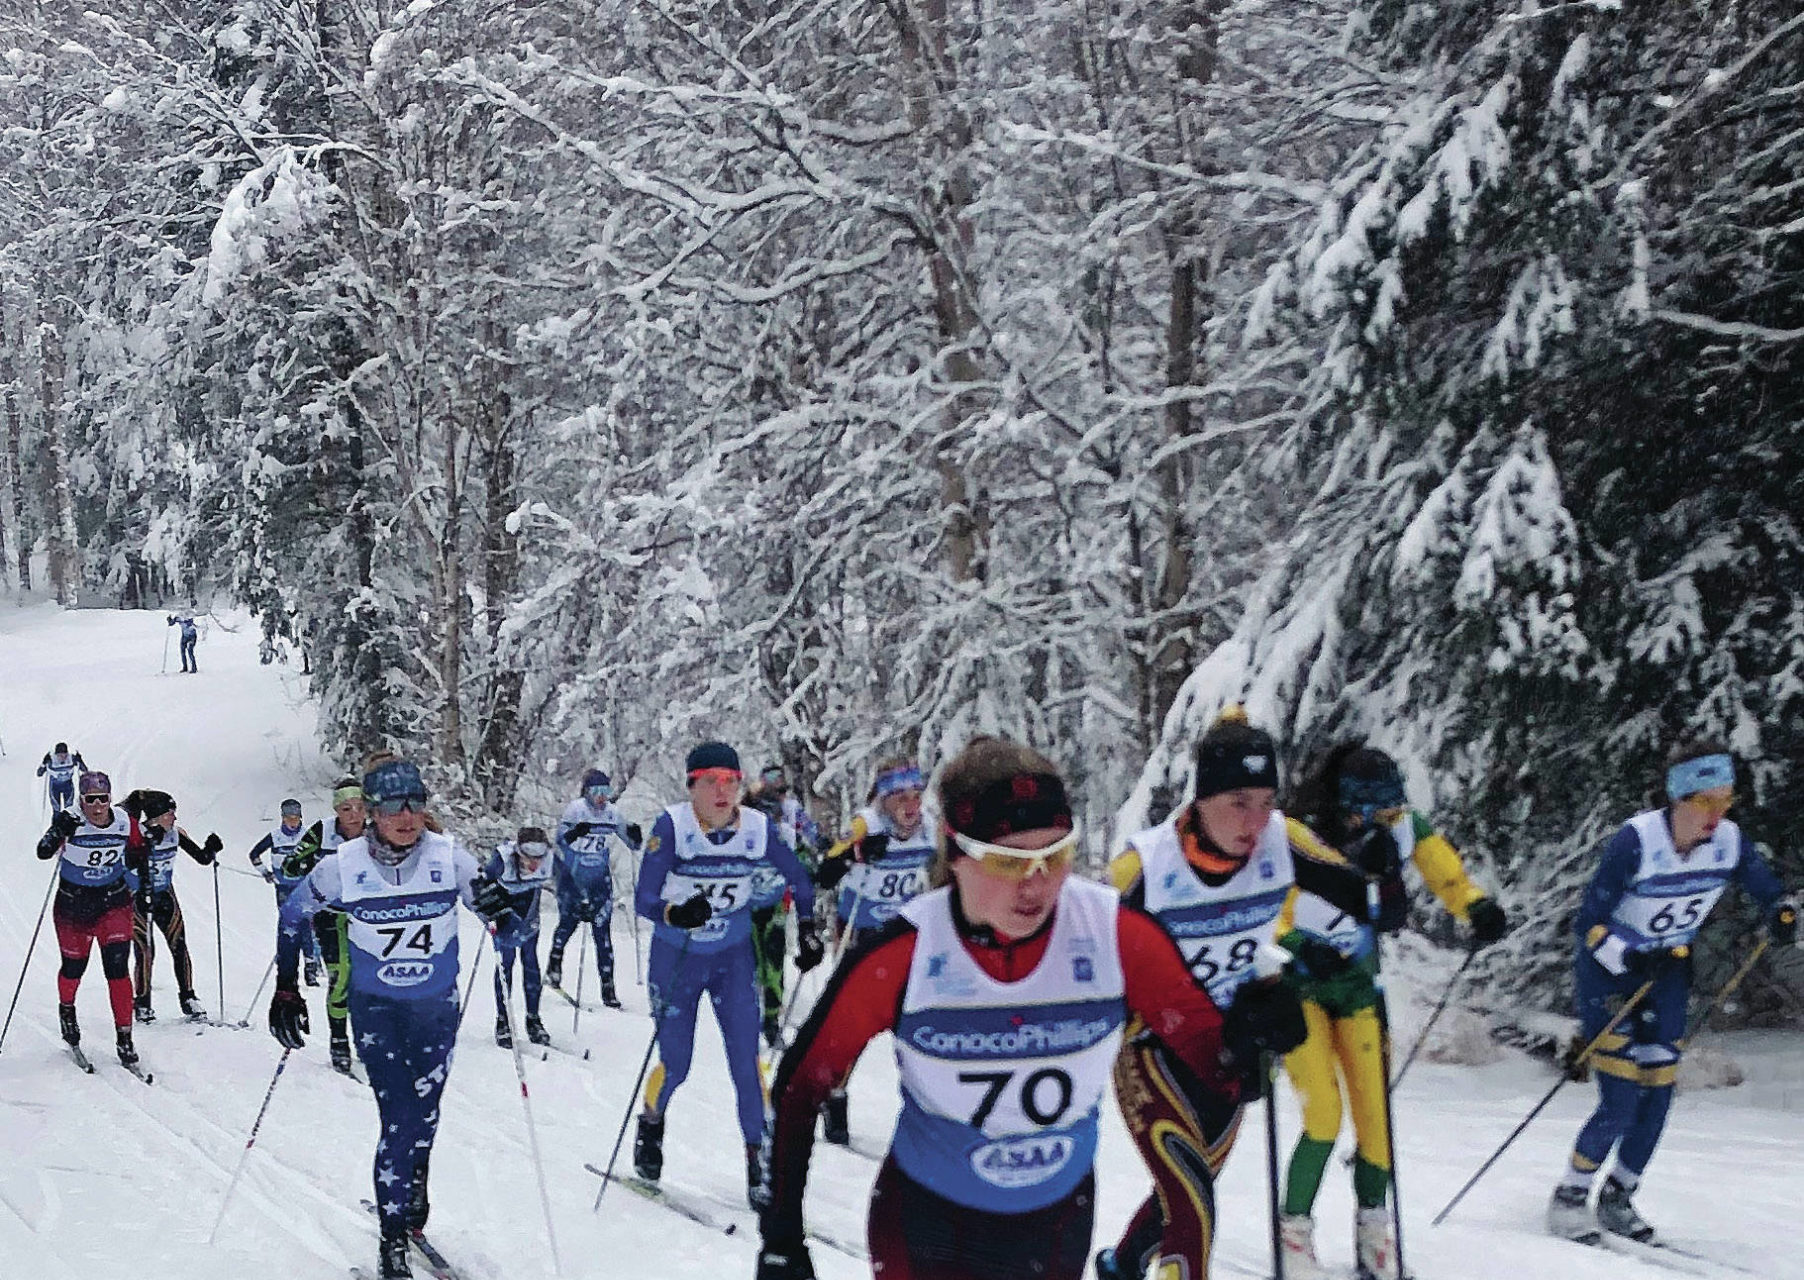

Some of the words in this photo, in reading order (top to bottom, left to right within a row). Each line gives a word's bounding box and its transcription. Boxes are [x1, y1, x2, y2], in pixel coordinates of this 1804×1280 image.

[87, 849, 119, 867] 82
[1650, 899, 1703, 932] 65
[375, 924, 434, 958] 74
[382, 965, 430, 979] ASAA
[1191, 938, 1258, 982] 68
[912, 1017, 1111, 1052] ConocoPhillips
[957, 1067, 1072, 1130] 70
